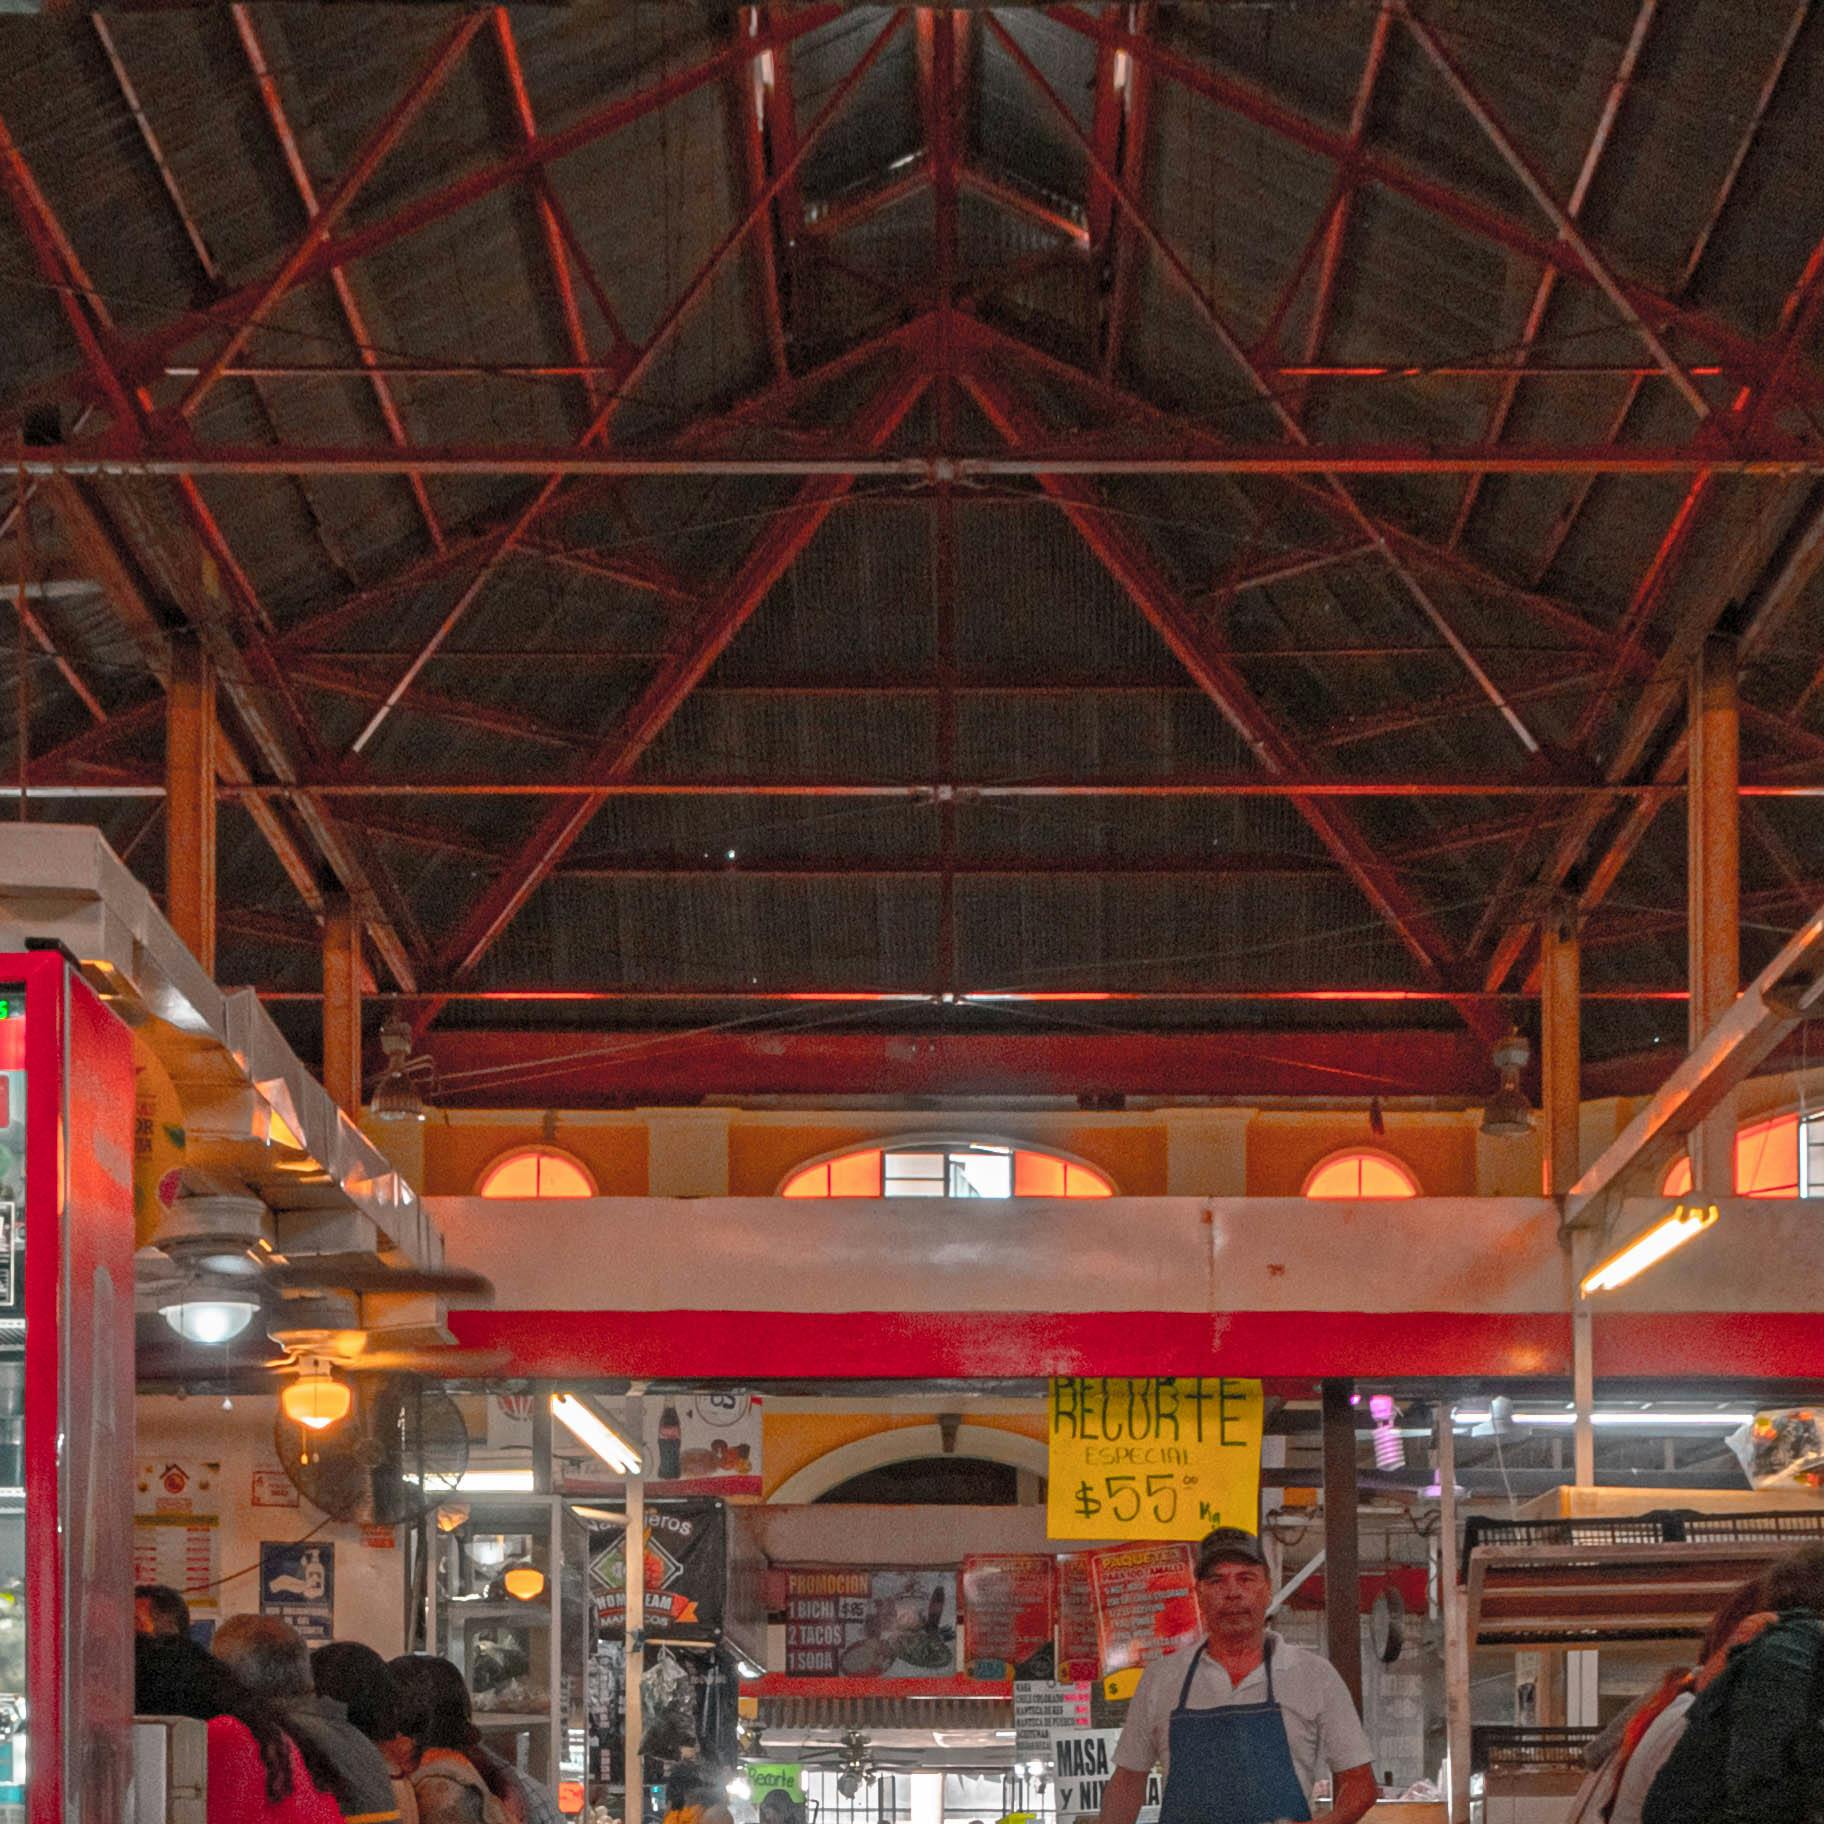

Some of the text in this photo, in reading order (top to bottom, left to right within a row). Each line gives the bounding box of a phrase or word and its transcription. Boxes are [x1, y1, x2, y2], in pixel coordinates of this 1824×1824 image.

[1084, 1447, 1192, 1466] ESPECIAL
[1073, 1473, 1178, 1524] $55
[788, 1625, 842, 1646] 2 TACOS
[798, 1652, 833, 1670] SODA
[1055, 1738, 1109, 1777] MASA
